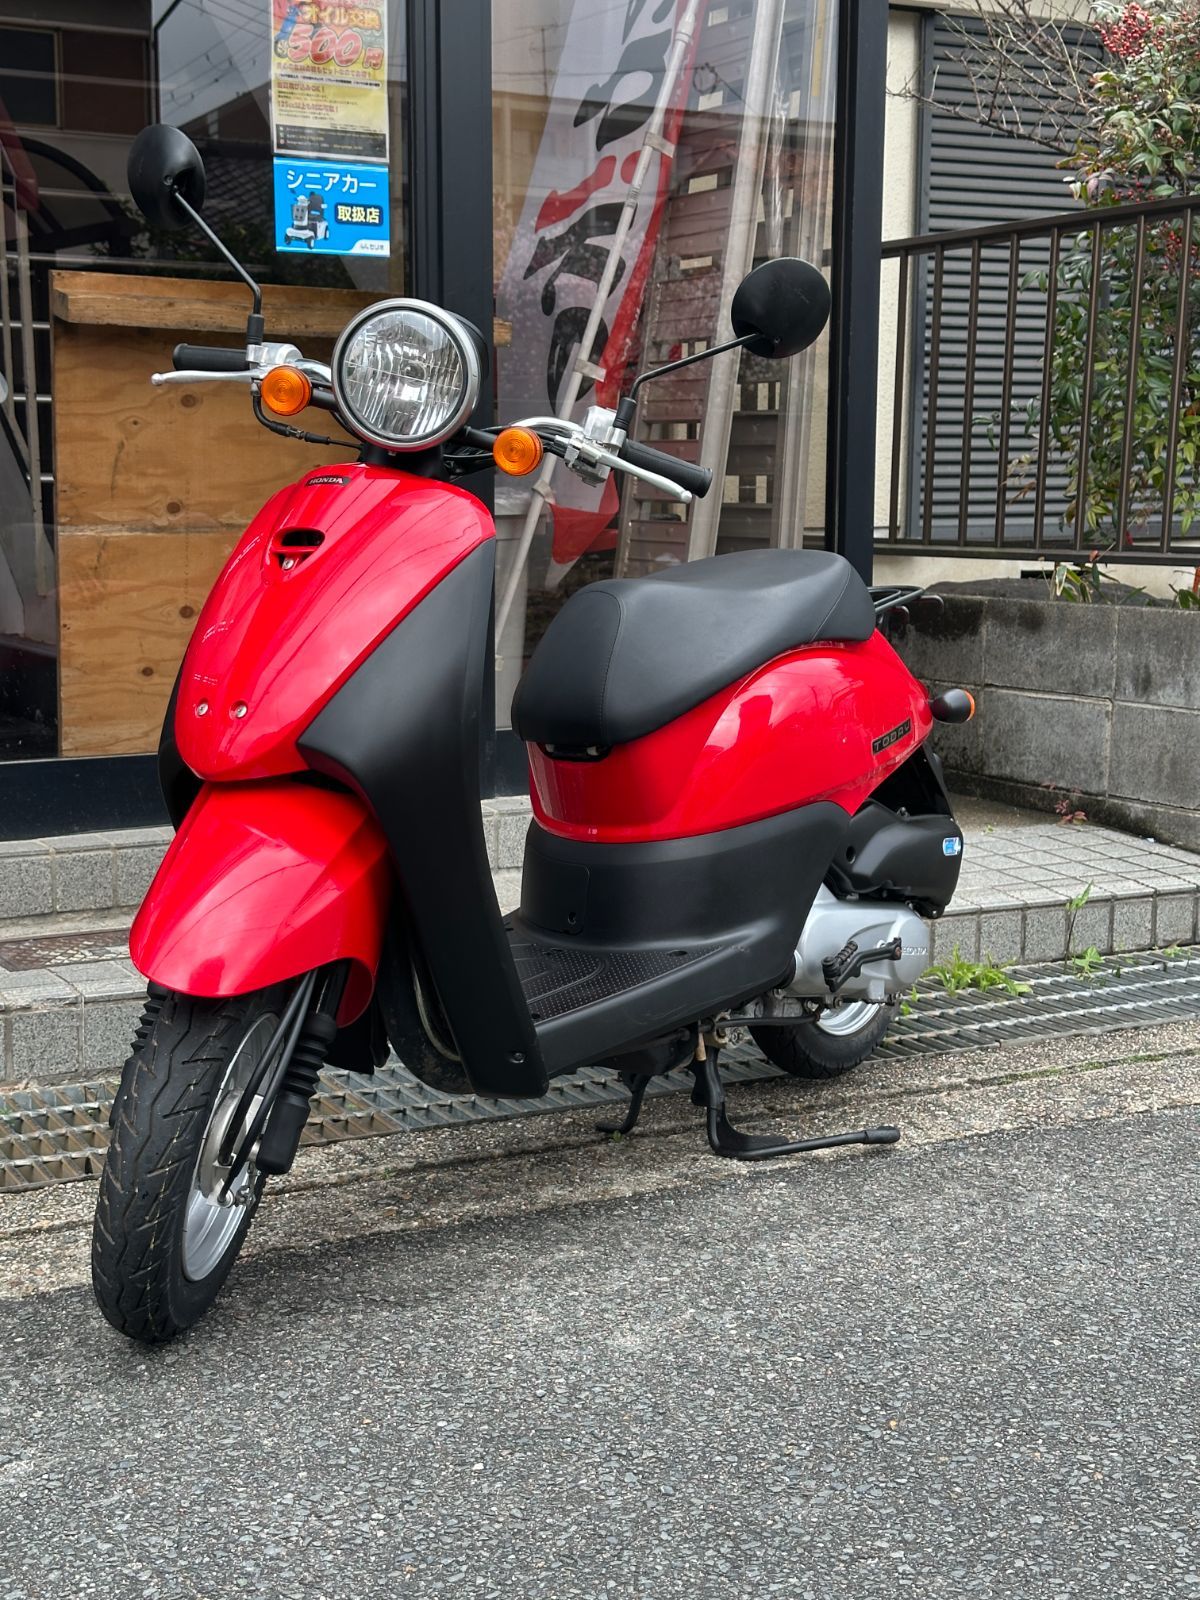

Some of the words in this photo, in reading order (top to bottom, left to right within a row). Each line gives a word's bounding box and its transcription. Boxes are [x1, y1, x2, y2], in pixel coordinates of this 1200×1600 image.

[301, 4, 382, 30] オイル交換
[287, 169, 377, 193] シニアカー
[337, 205, 380, 223] 取扱店
[873, 719, 910, 751] TODAY
